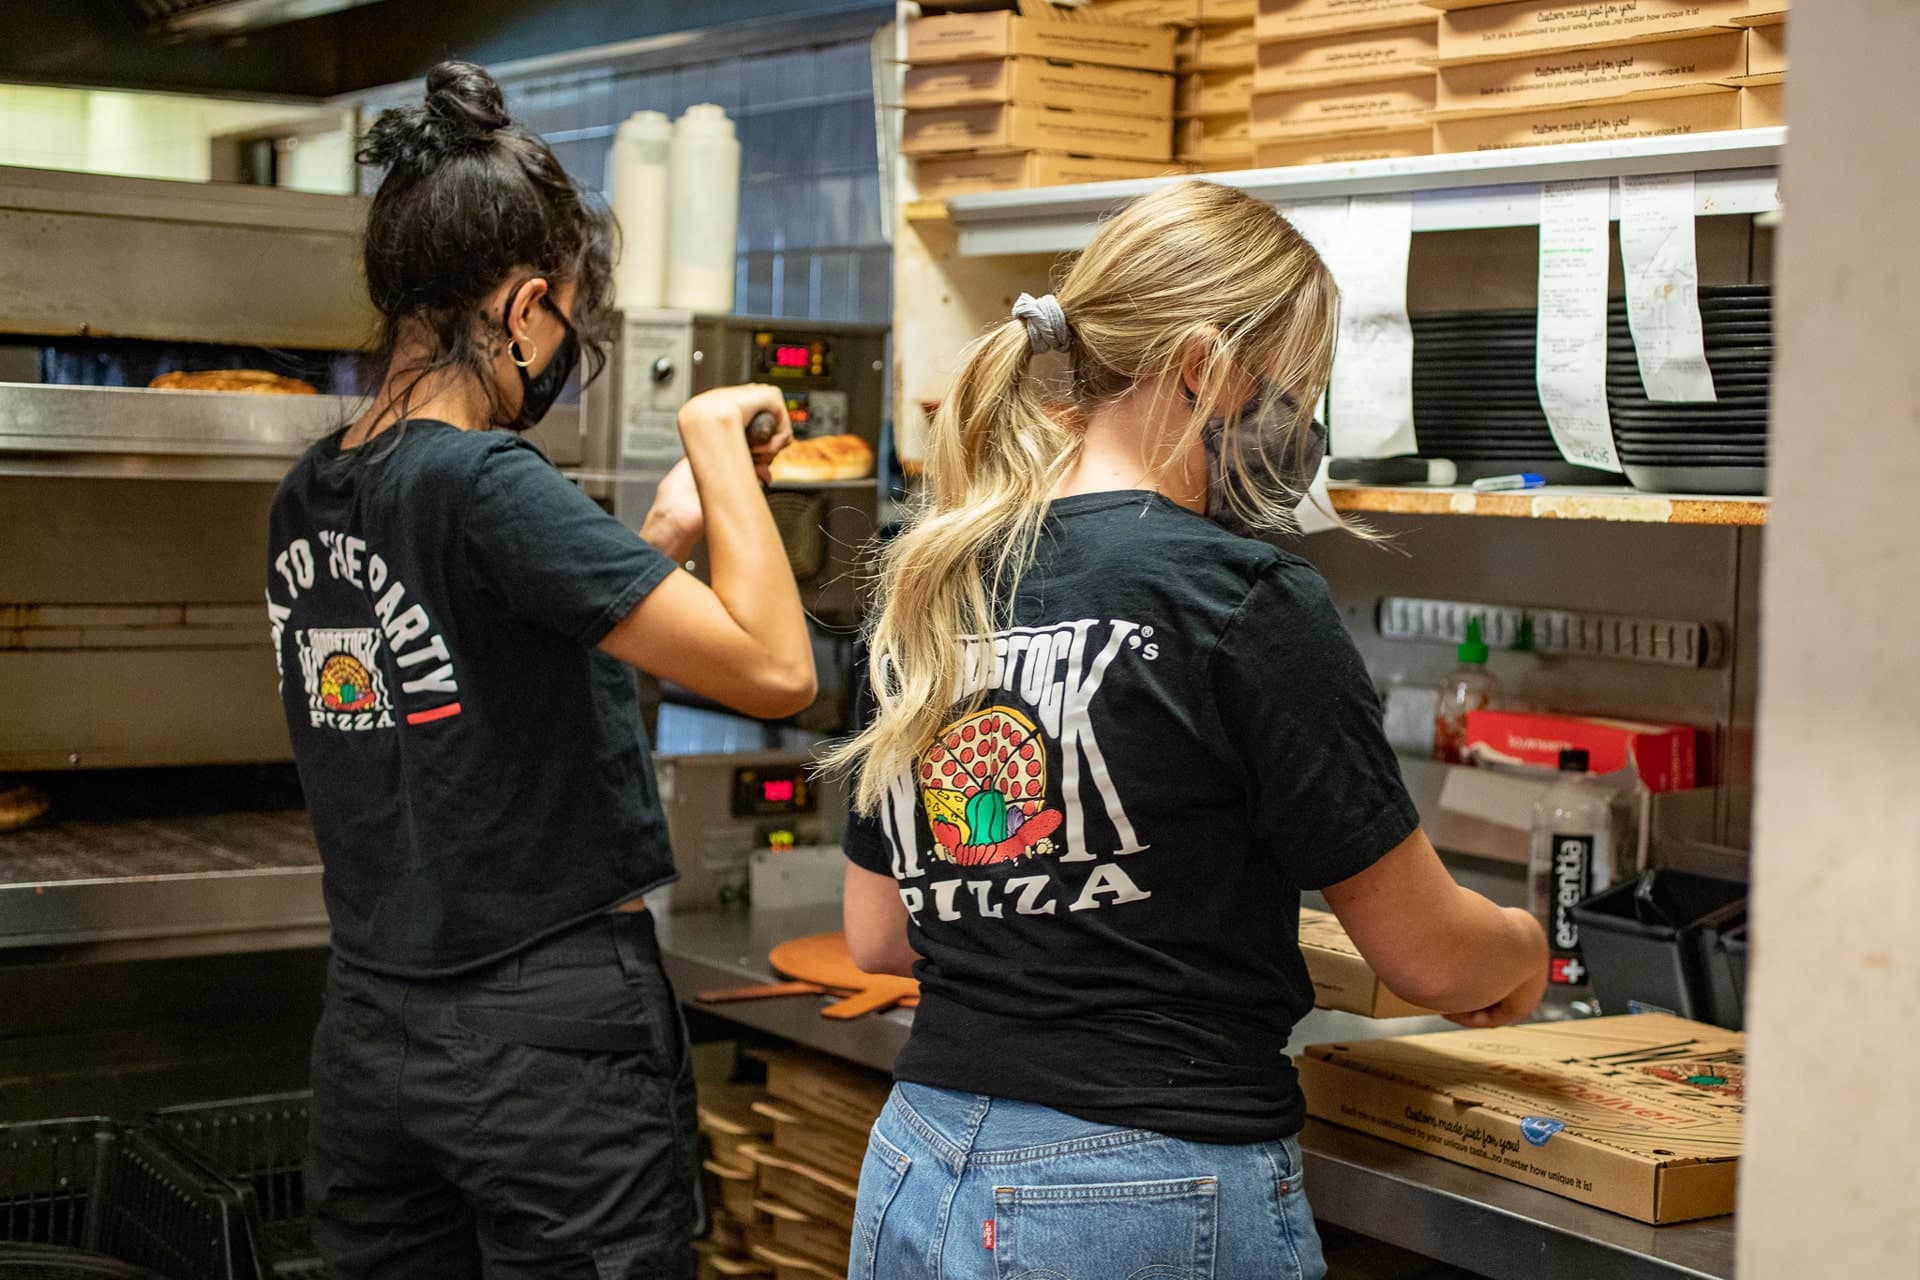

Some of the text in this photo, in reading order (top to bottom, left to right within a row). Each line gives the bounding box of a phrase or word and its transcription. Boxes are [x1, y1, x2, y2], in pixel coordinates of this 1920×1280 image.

[275, 539, 315, 599] TO
[310, 710, 396, 731] PIZZA
[900, 862, 1151, 927] PIZZA
[1405, 1105, 1437, 1127] Custom
[1439, 1117, 1462, 1136] made
[1462, 1123, 1481, 1141] just
[1482, 1128, 1498, 1148] for
[1500, 1138, 1520, 1154] you!
[1443, 1136, 1467, 1152] unique
[1503, 1157, 1528, 1172] matter
[1529, 1163, 1546, 1177] how
[1548, 1170, 1574, 1187] unique
[1583, 1180, 1592, 1192] is!
